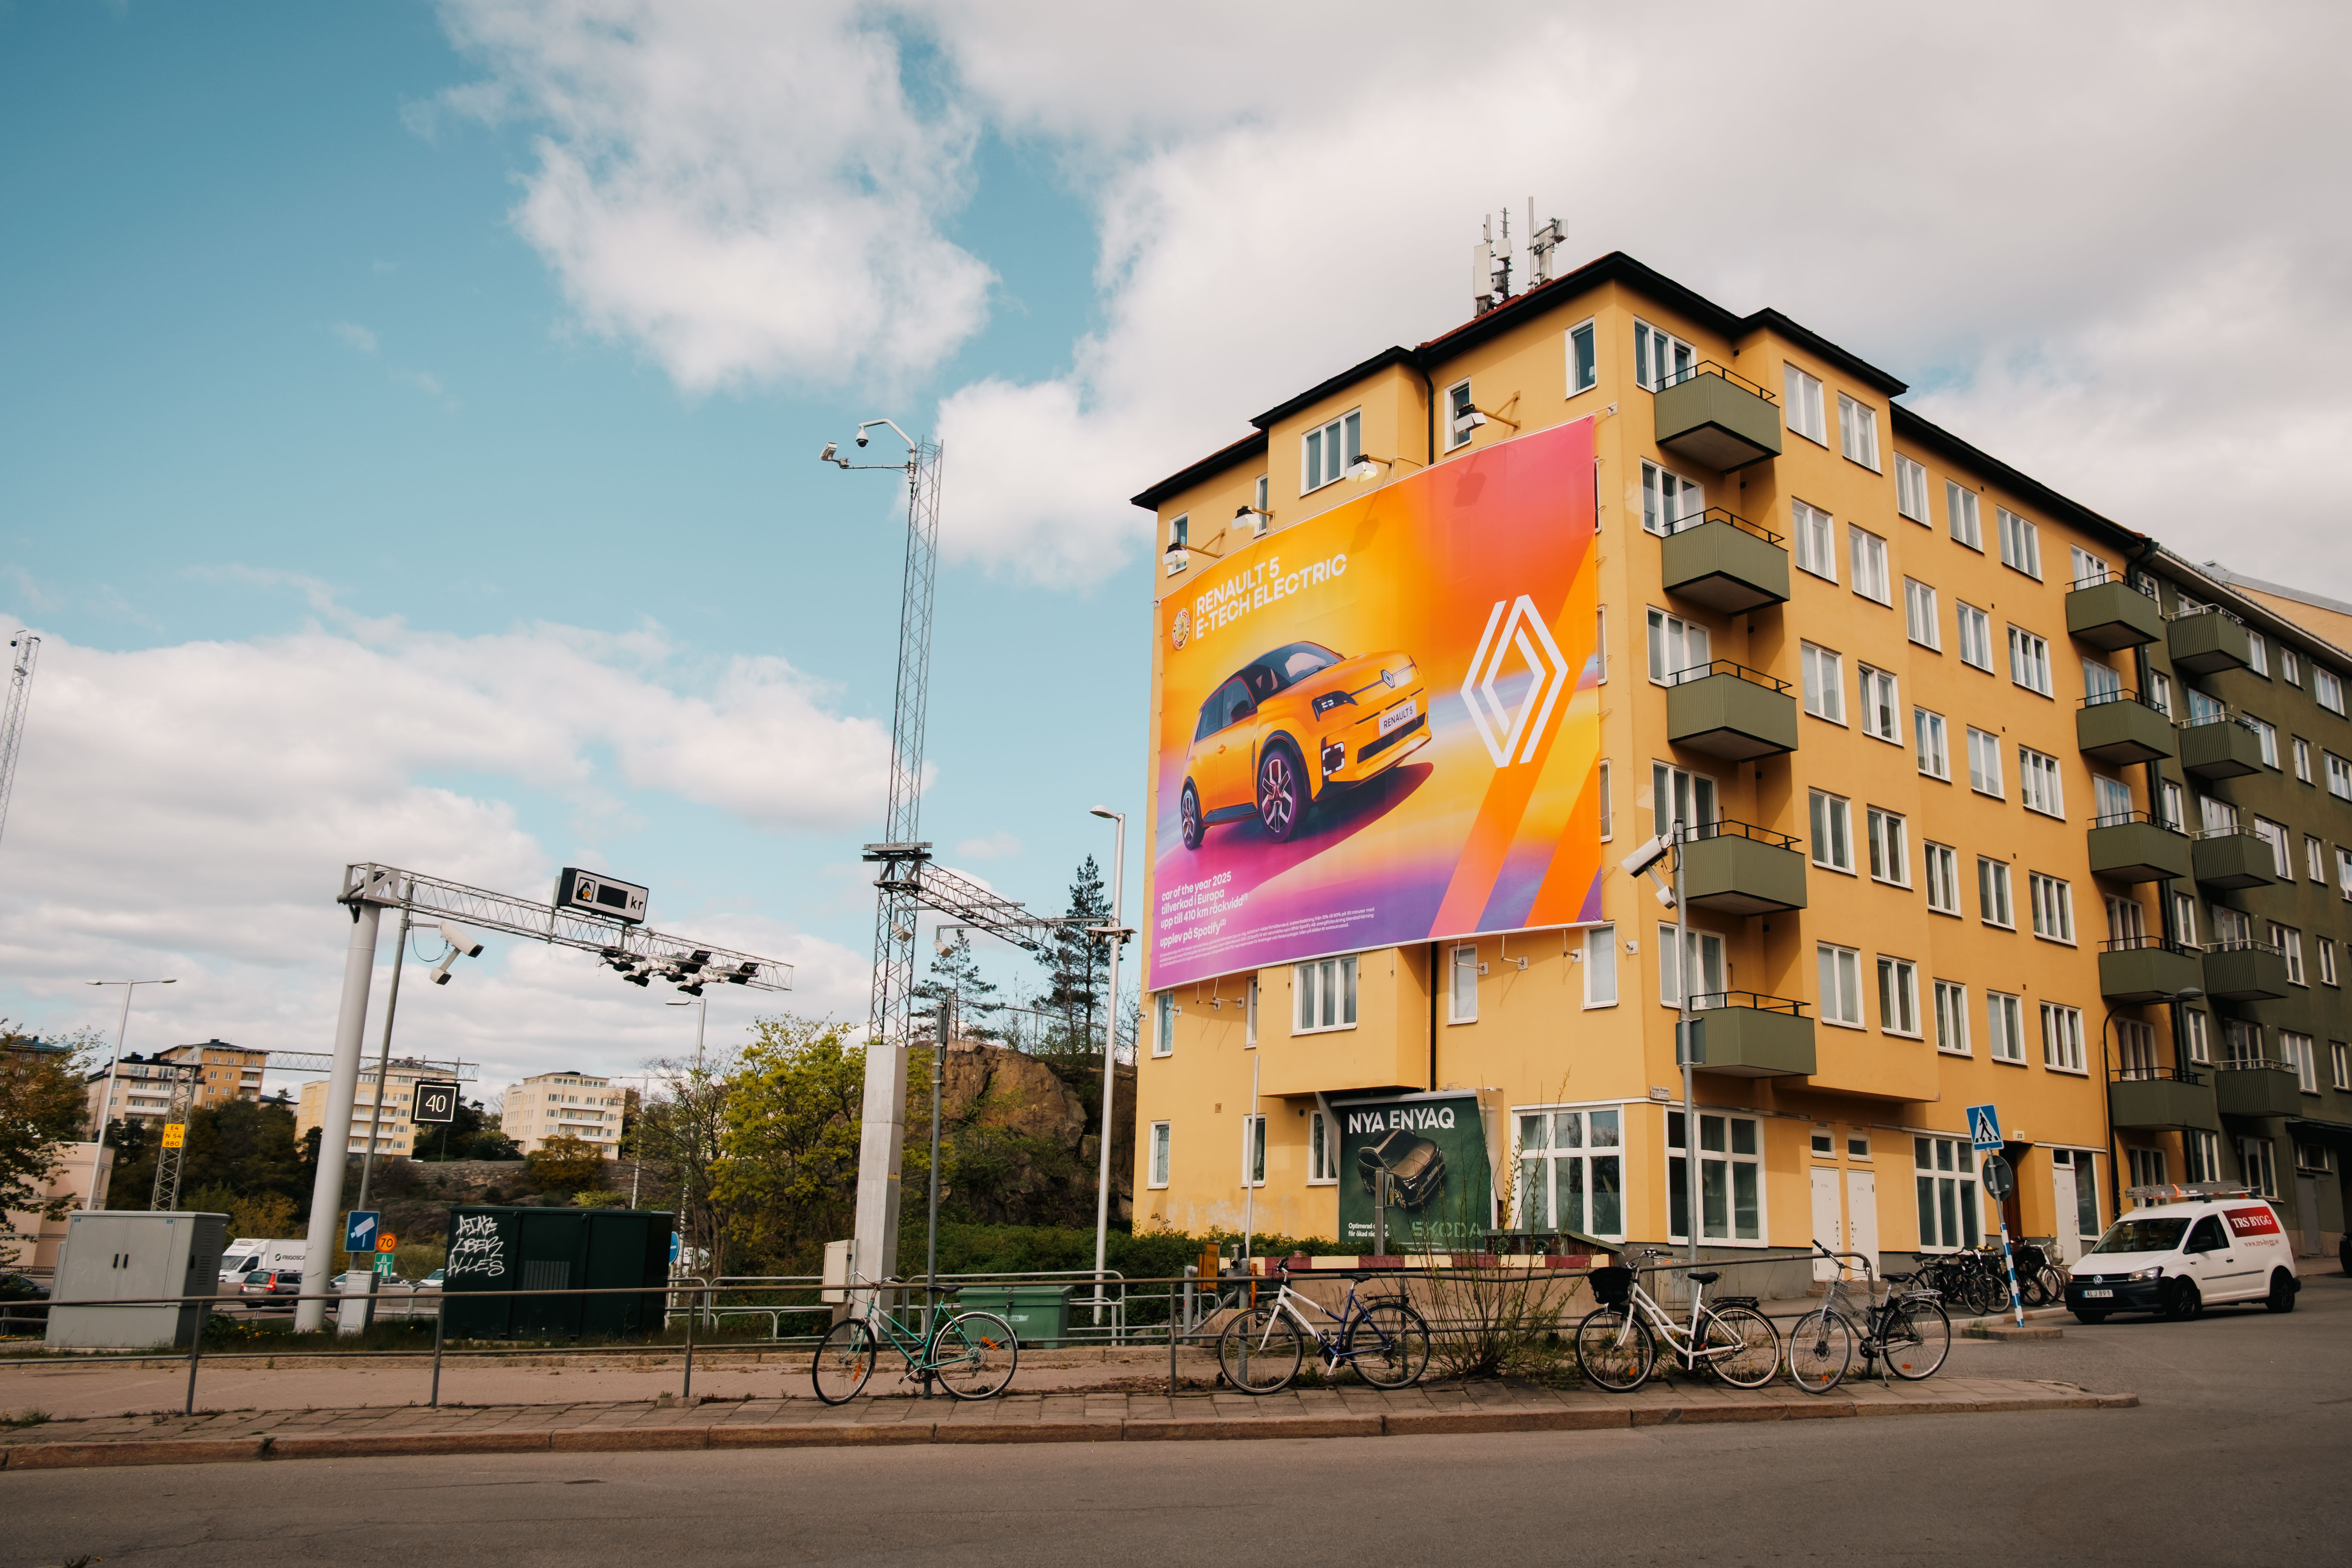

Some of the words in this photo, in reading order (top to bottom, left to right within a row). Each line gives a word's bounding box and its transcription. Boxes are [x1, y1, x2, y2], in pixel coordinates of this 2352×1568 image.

[1196, 562, 1266, 617] RENAULT
[1269, 556, 1279, 578] 5
[1196, 594, 1250, 639] E-TECH
[1254, 554, 1347, 610] ELECTRIC
[1384, 708, 1409, 729] RENAULT
[1410, 706, 1412, 714] 5
[1162, 890, 1173, 901] car
[1173, 885, 1181, 897] of
[1181, 884, 1194, 895] the
[1194, 879, 1212, 894] year
[1212, 871, 1231, 887] 2025
[631, 896, 643, 910] kr
[1161, 895, 1193, 915] tillverkad
[1194, 894, 1197, 905] i
[1197, 889, 1225, 905] Europa
[1161, 917, 1173, 930] upp
[1174, 912, 1183, 925] till
[1184, 909, 1196, 922] 410
[1197, 907, 1208, 919] km
[1160, 933, 1183, 949] upplev
[1183, 927, 1193, 943] på
[426, 1095, 446, 1112] 40
[1349, 1112, 1384, 1133] NYA
[1390, 1107, 1455, 1130] ENYAQ
[2231, 1217, 2249, 1228] TRS
[2248, 1215, 2272, 1226] BYGG
[381, 1238, 393, 1248] 70
[446, 1254, 505, 1277] ALLES
